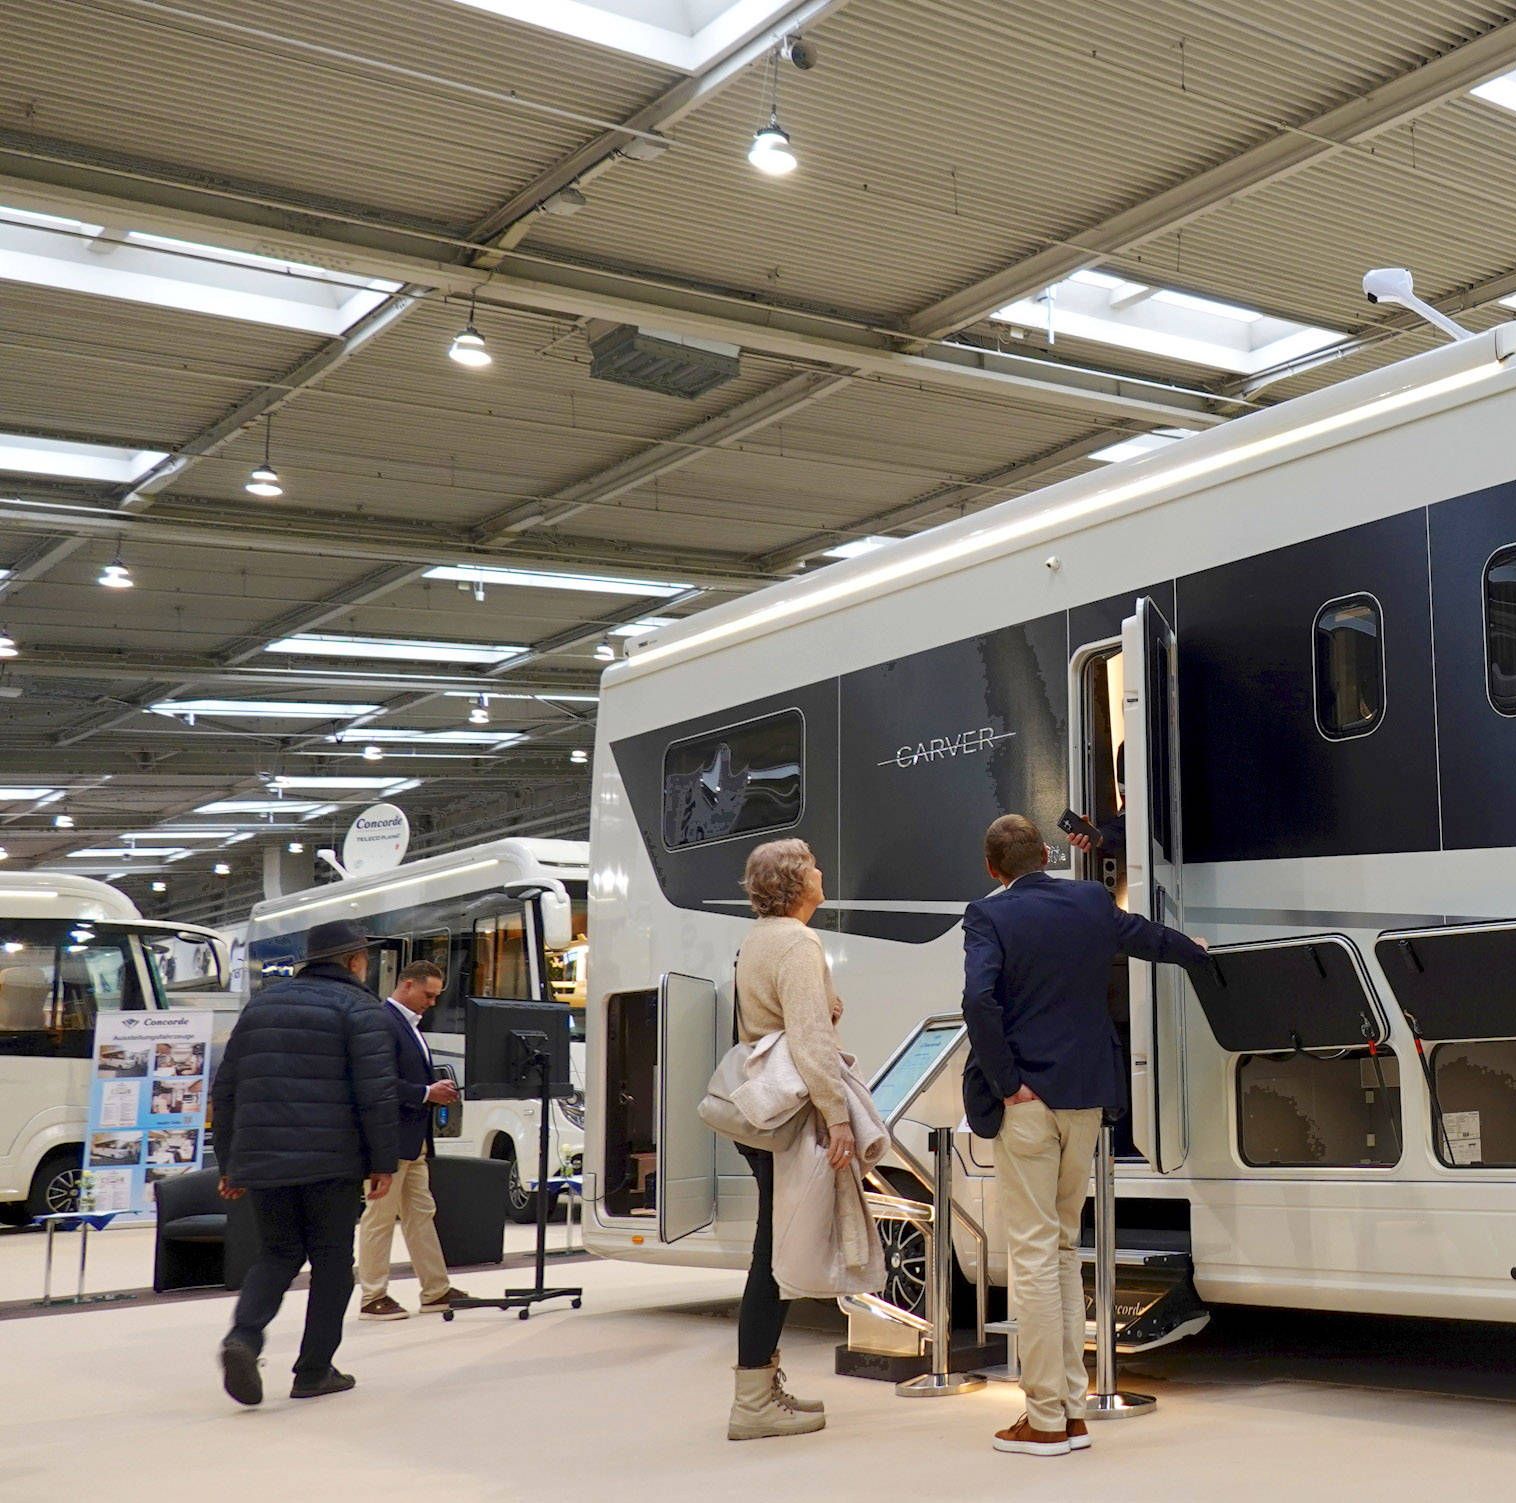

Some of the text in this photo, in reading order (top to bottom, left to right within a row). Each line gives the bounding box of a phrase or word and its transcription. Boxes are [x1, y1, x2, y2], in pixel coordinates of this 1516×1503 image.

[896, 727, 994, 768] CARVER
[356, 816, 403, 830] Concorde
[143, 1017, 190, 1027] Concorde
